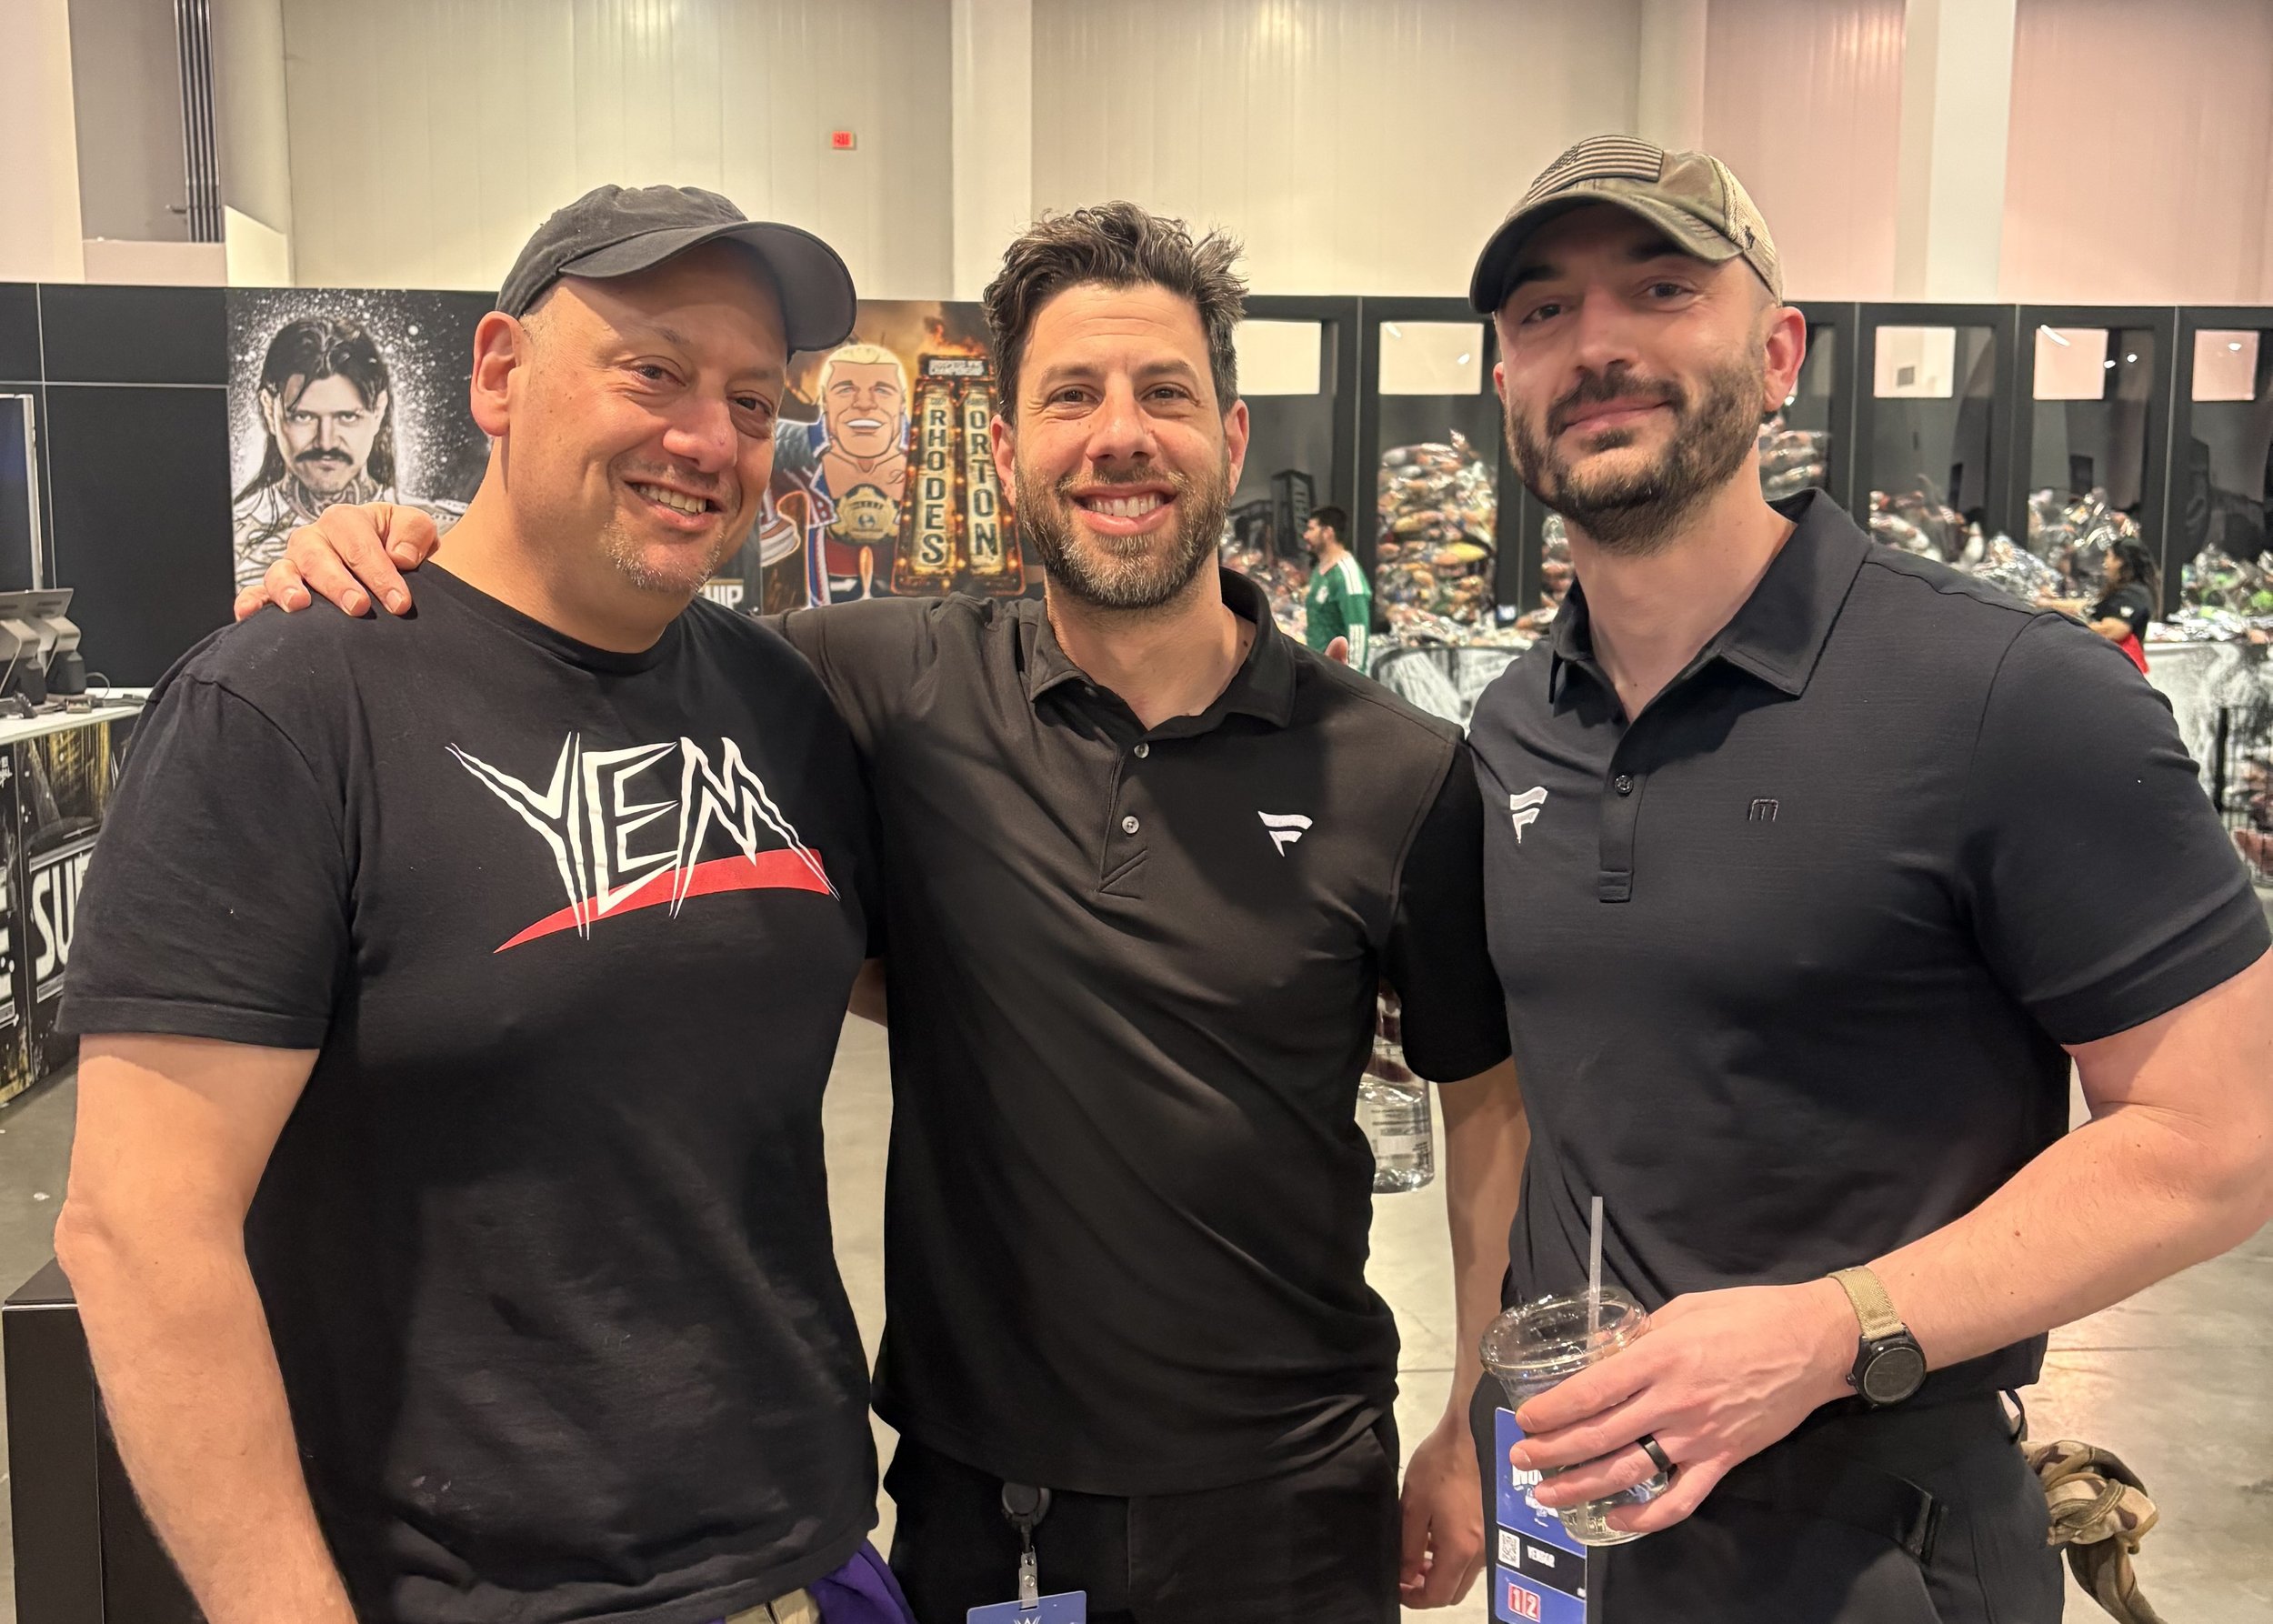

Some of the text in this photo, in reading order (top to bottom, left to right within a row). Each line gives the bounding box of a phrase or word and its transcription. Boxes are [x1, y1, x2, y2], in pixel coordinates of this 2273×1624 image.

[922, 409, 947, 564] RHODES
[969, 410, 998, 556] ORTON
[699, 585, 744, 611] HIP
[446, 731, 840, 940] YEM
